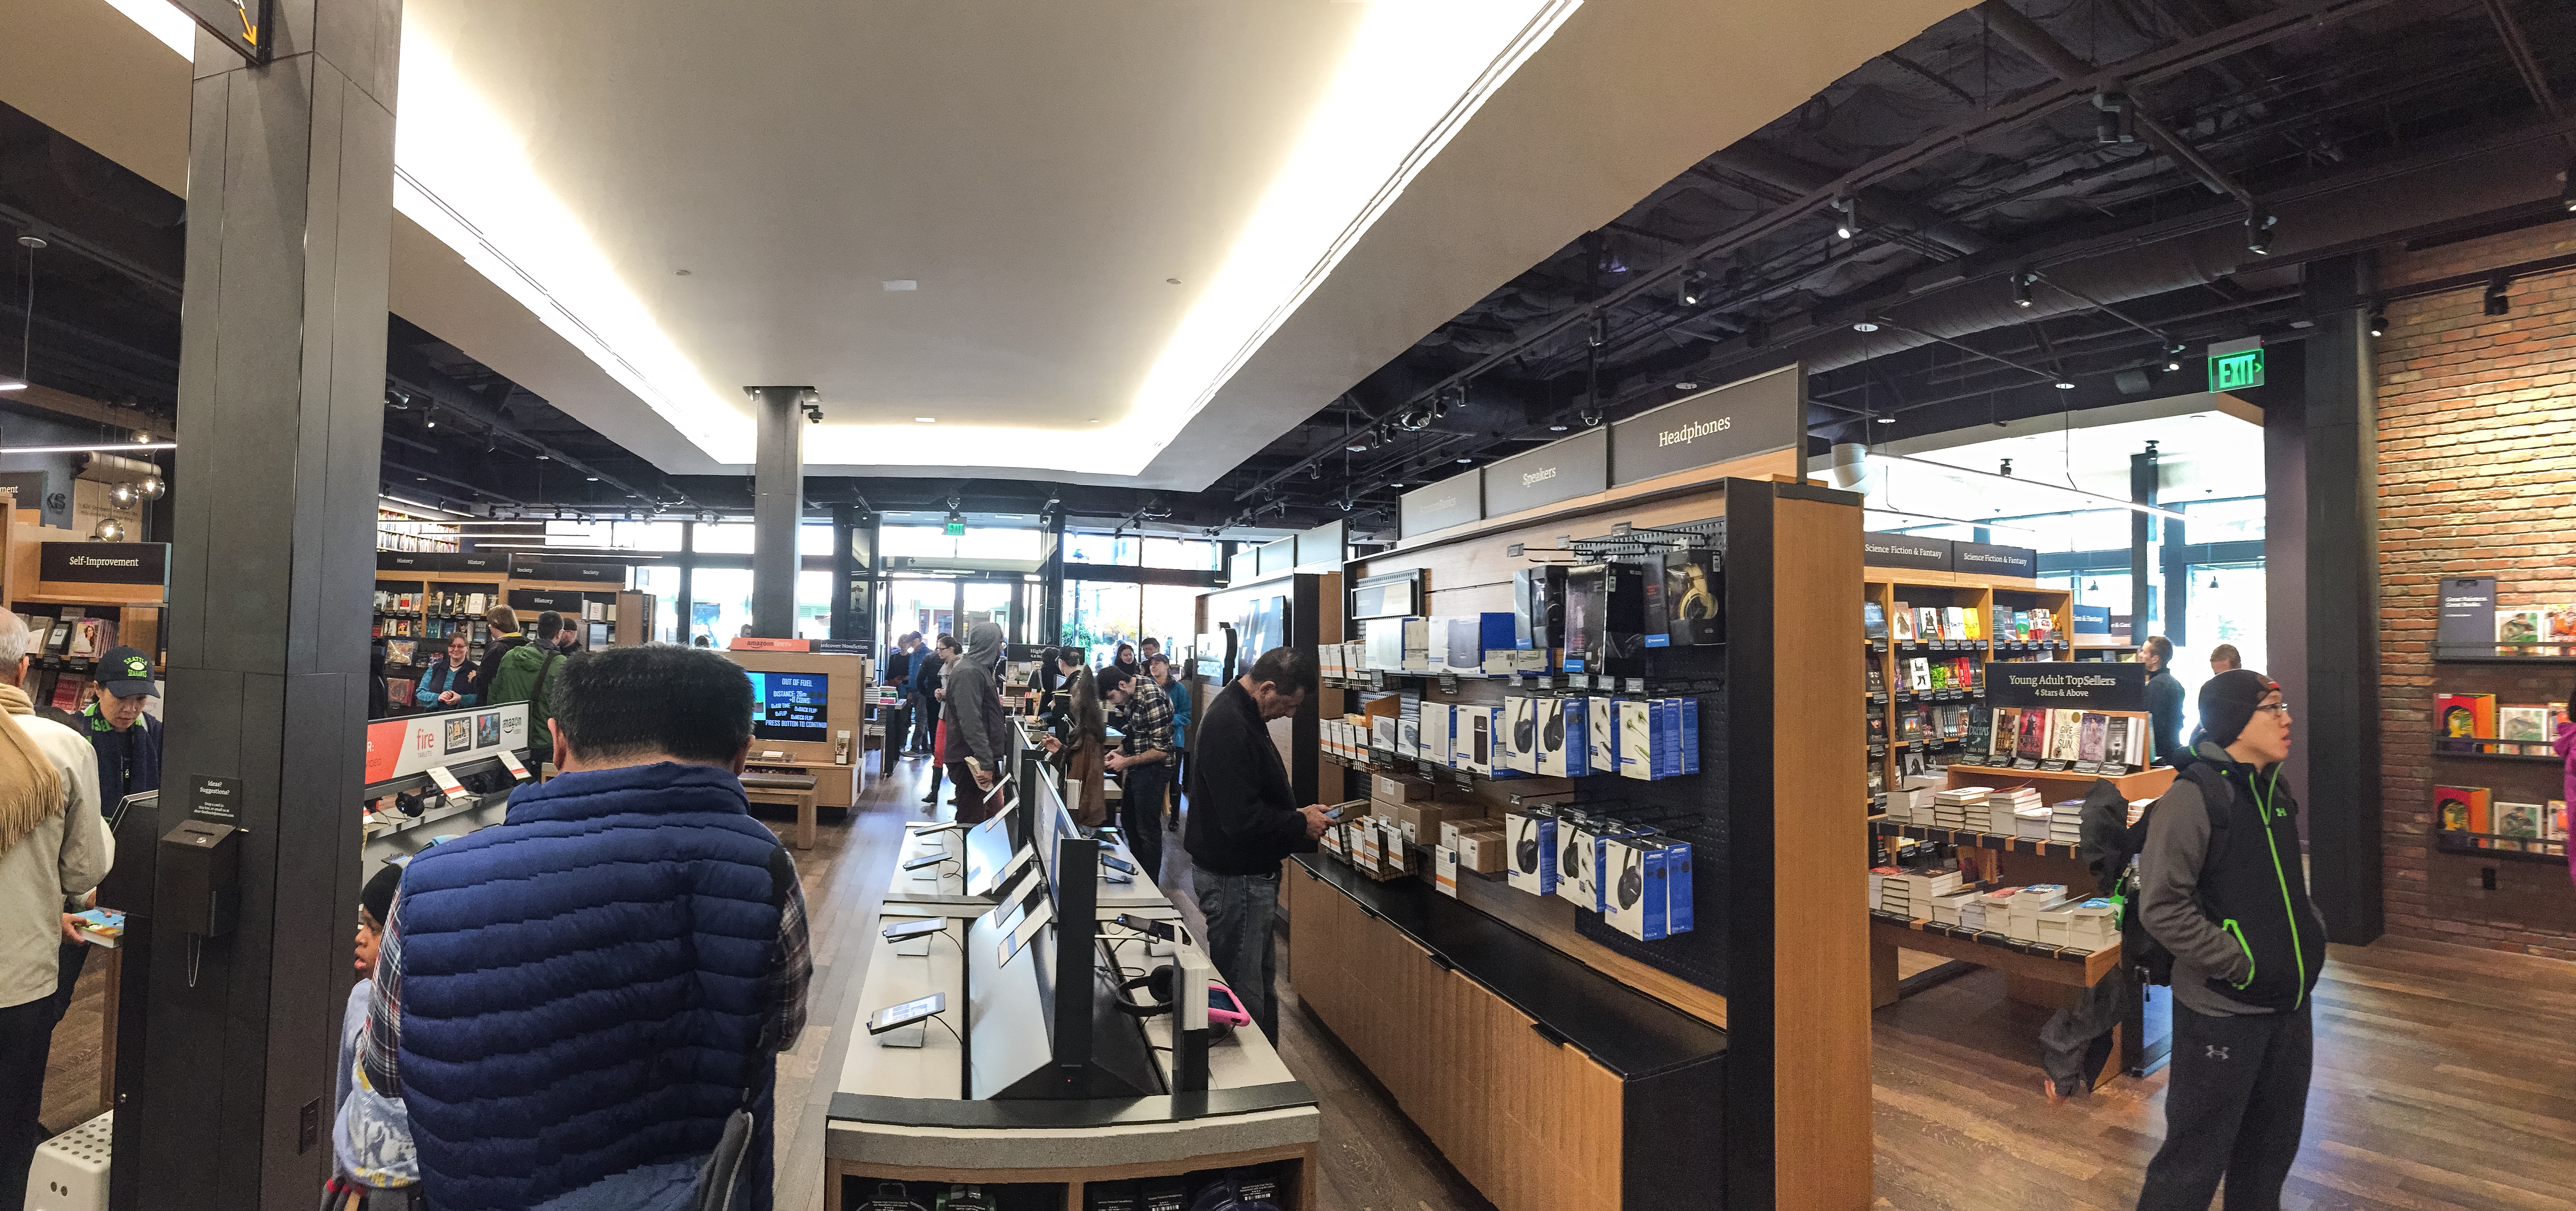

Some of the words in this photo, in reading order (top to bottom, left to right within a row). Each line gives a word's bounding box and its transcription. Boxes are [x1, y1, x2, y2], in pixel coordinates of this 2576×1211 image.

[2219, 354, 2255, 389] EXIT
[1659, 417, 1731, 447] Headphones
[1523, 467, 1556, 487] Speakers
[1865, 544, 1889, 553] Science
[1891, 545, 1913, 555] Fiction
[1919, 549, 1942, 559] Fantasy
[70, 556, 139, 567] Self-Improvement
[1963, 552, 1984, 561] Science
[1985, 554, 2003, 562] Fiction
[2008, 557, 2027, 566] Fantasy
[2009, 675, 2038, 687] Young
[2039, 674, 2065, 685] Adult
[2065, 675, 2116, 687] TopSellers
[1968, 725, 1990, 736] DREAMS
[2060, 726, 2073, 734] GIVE
[417, 728, 434, 750] fire
[2058, 739, 2073, 749] SUN
[200, 787, 230, 795] Suggestions?
